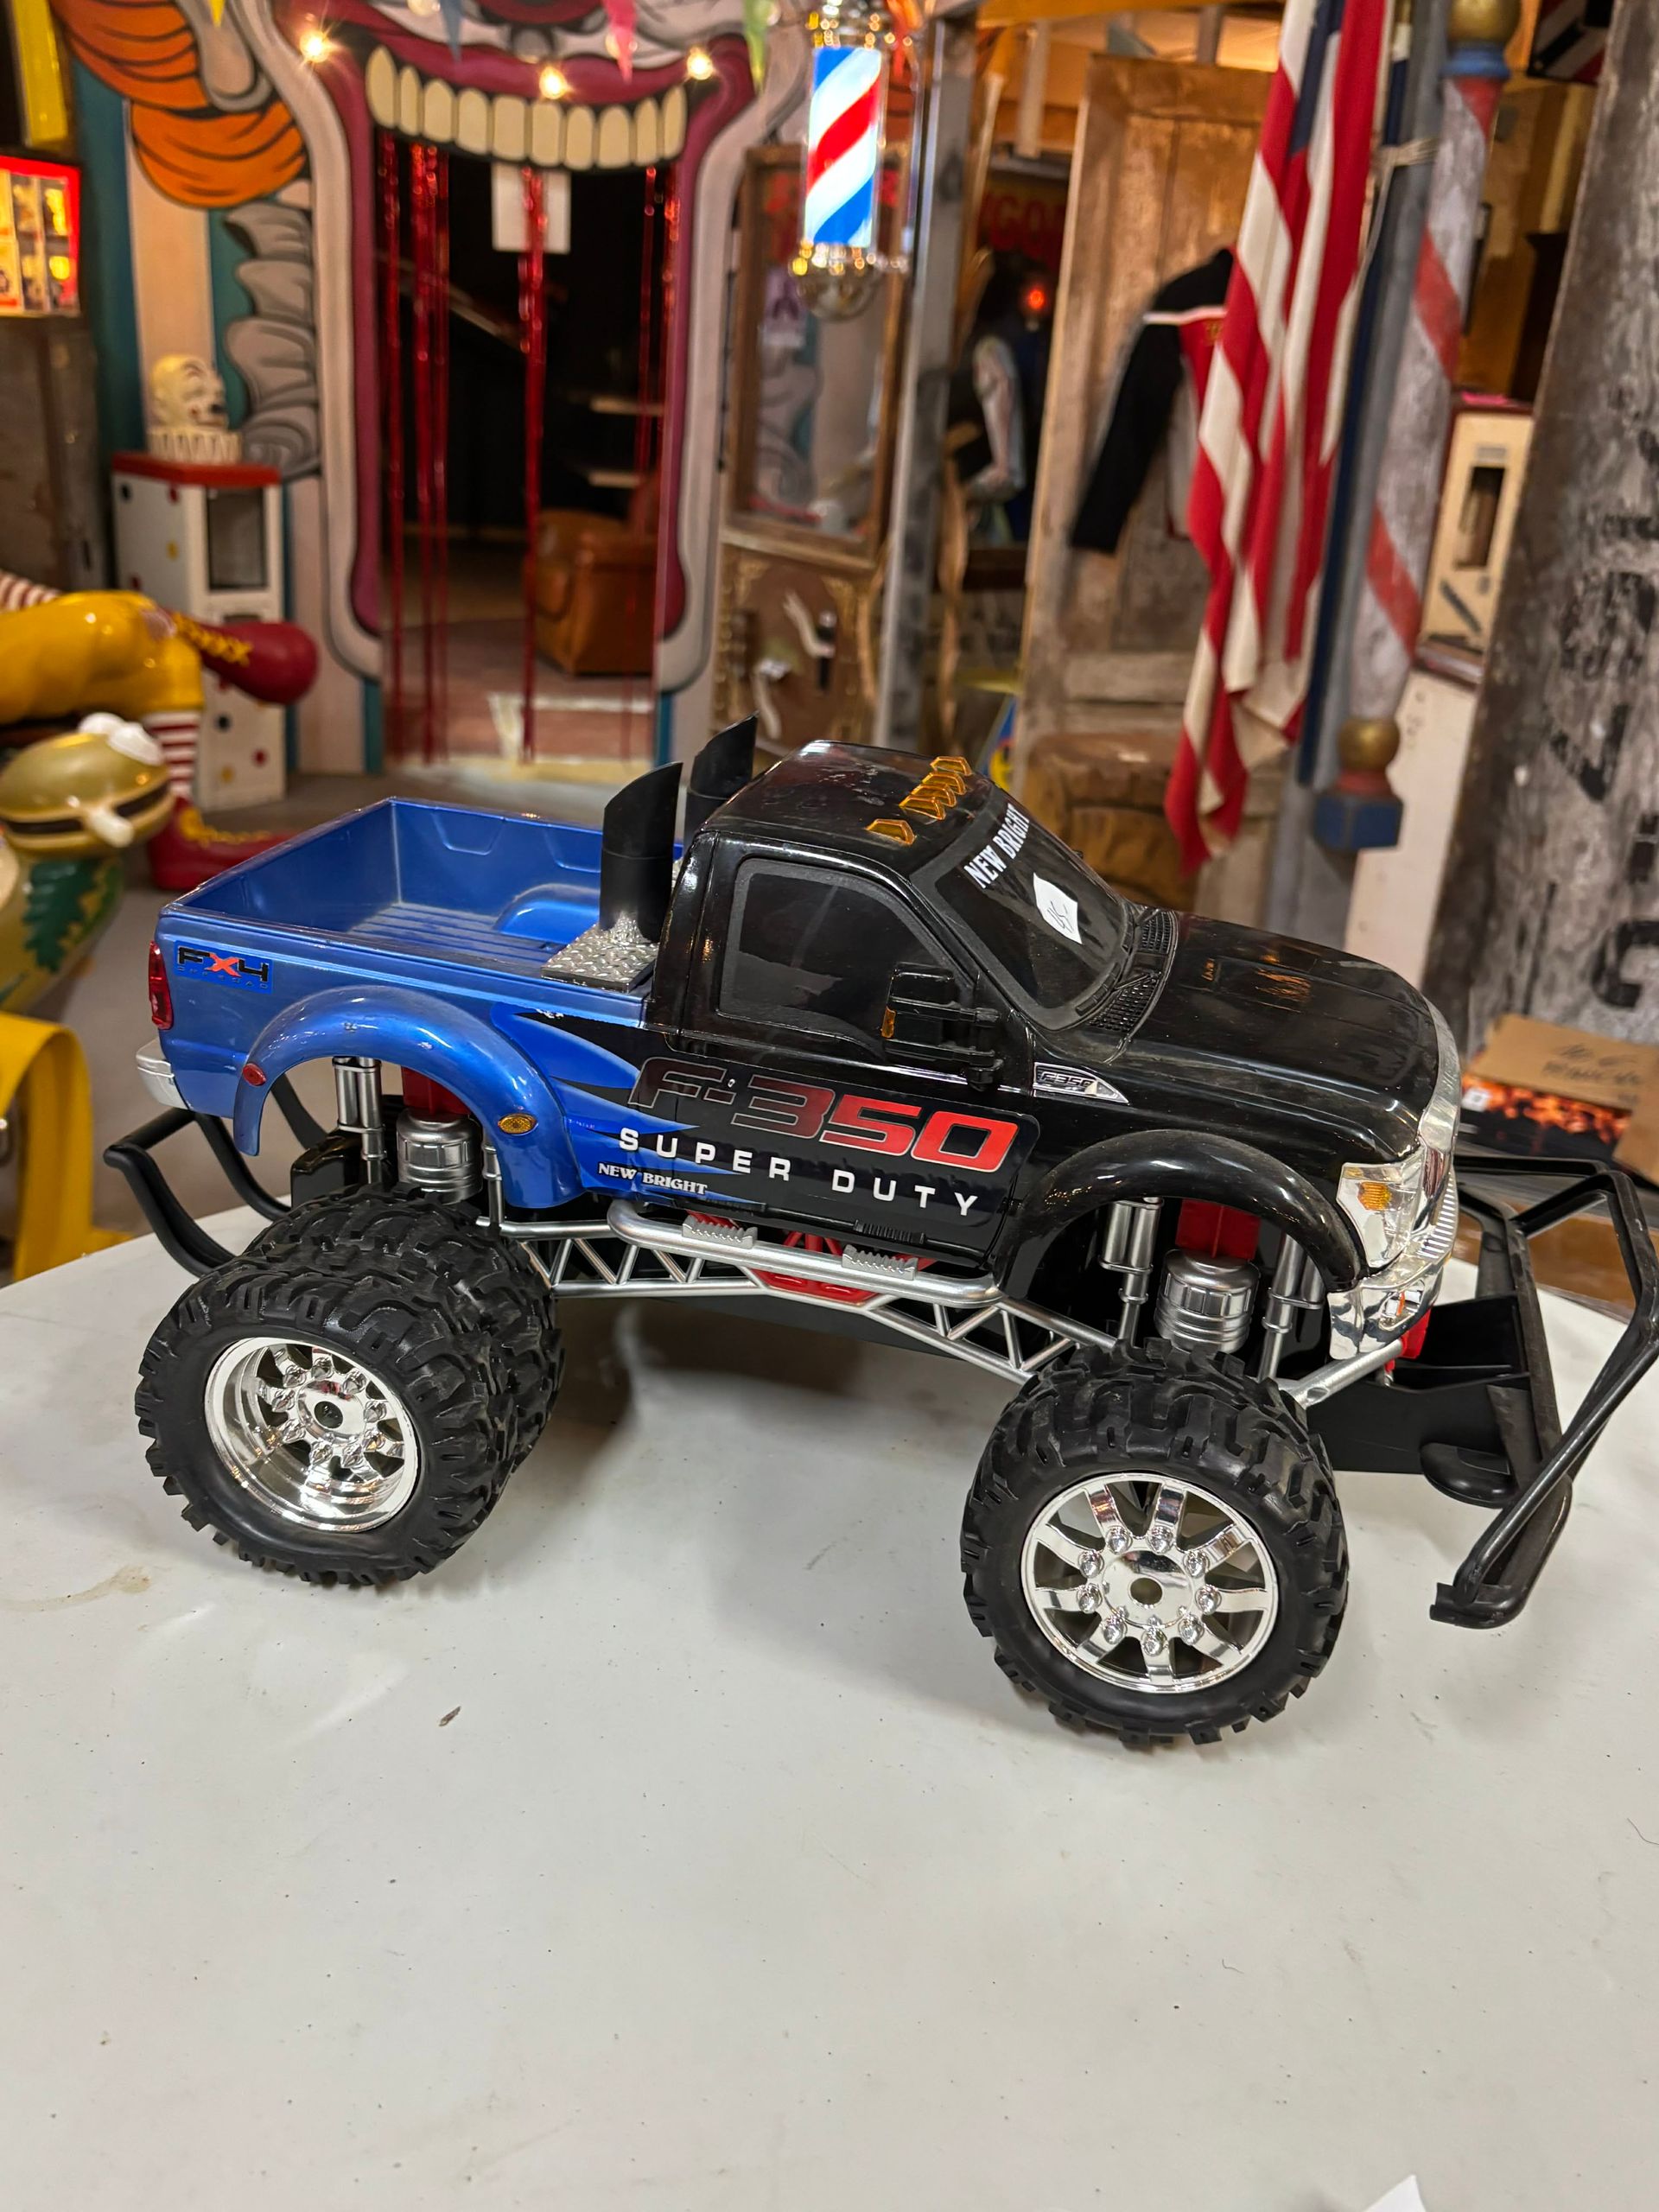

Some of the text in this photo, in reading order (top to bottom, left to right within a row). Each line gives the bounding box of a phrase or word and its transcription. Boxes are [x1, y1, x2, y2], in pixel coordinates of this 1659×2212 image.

[963, 803, 1030, 889] NEW BRIGHT
[177, 945, 270, 982] FX4
[627, 1056, 1020, 1173] F-350
[598, 1162, 709, 1195] NEW BRIGHT
[619, 1127, 978, 1217] SUPER DUTY
